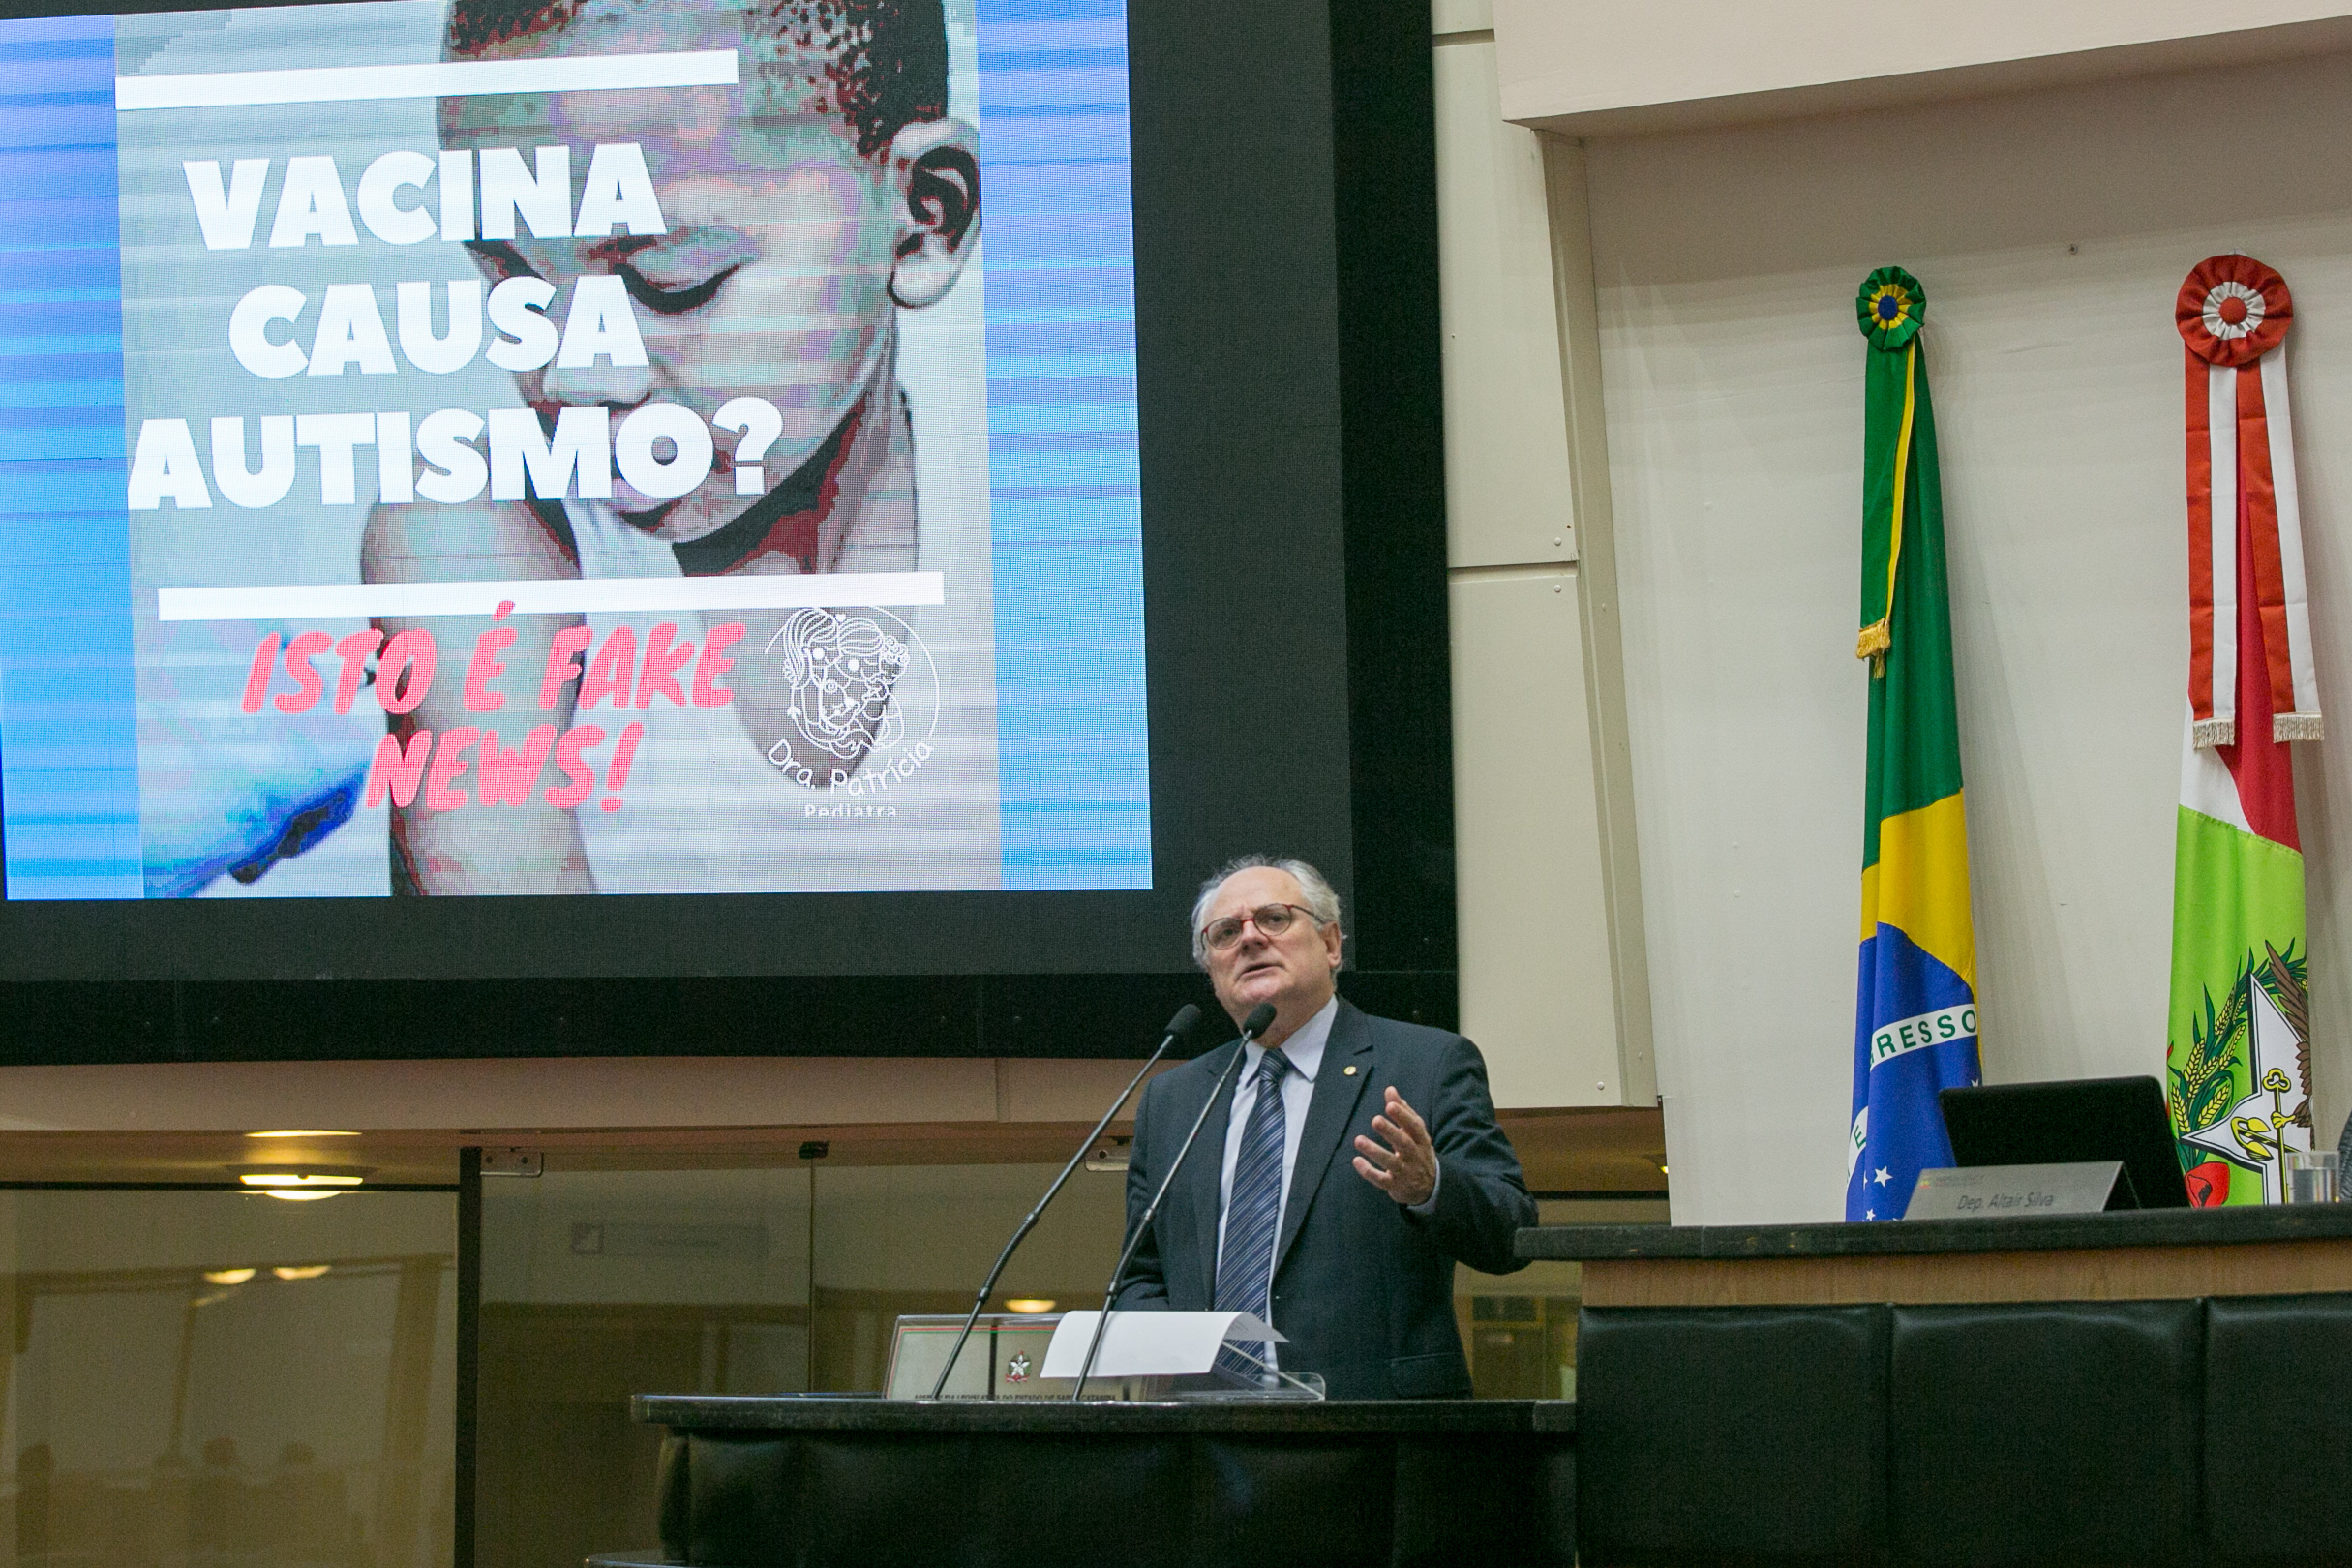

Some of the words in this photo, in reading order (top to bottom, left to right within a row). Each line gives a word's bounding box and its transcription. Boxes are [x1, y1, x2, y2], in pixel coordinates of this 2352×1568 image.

[182, 142, 668, 251] VACINA
[228, 274, 650, 379] CAUSA
[127, 396, 784, 511] AUTISMO?
[241, 627, 437, 715] ISTO
[463, 600, 518, 712] É
[538, 622, 746, 711] FAKE
[365, 721, 644, 812] NEWS!
[768, 738, 816, 789] Dra.
[830, 741, 934, 796] Patrícia
[804, 802, 896, 817] Pediatra
[1869, 1010, 1977, 1064] RESSO
